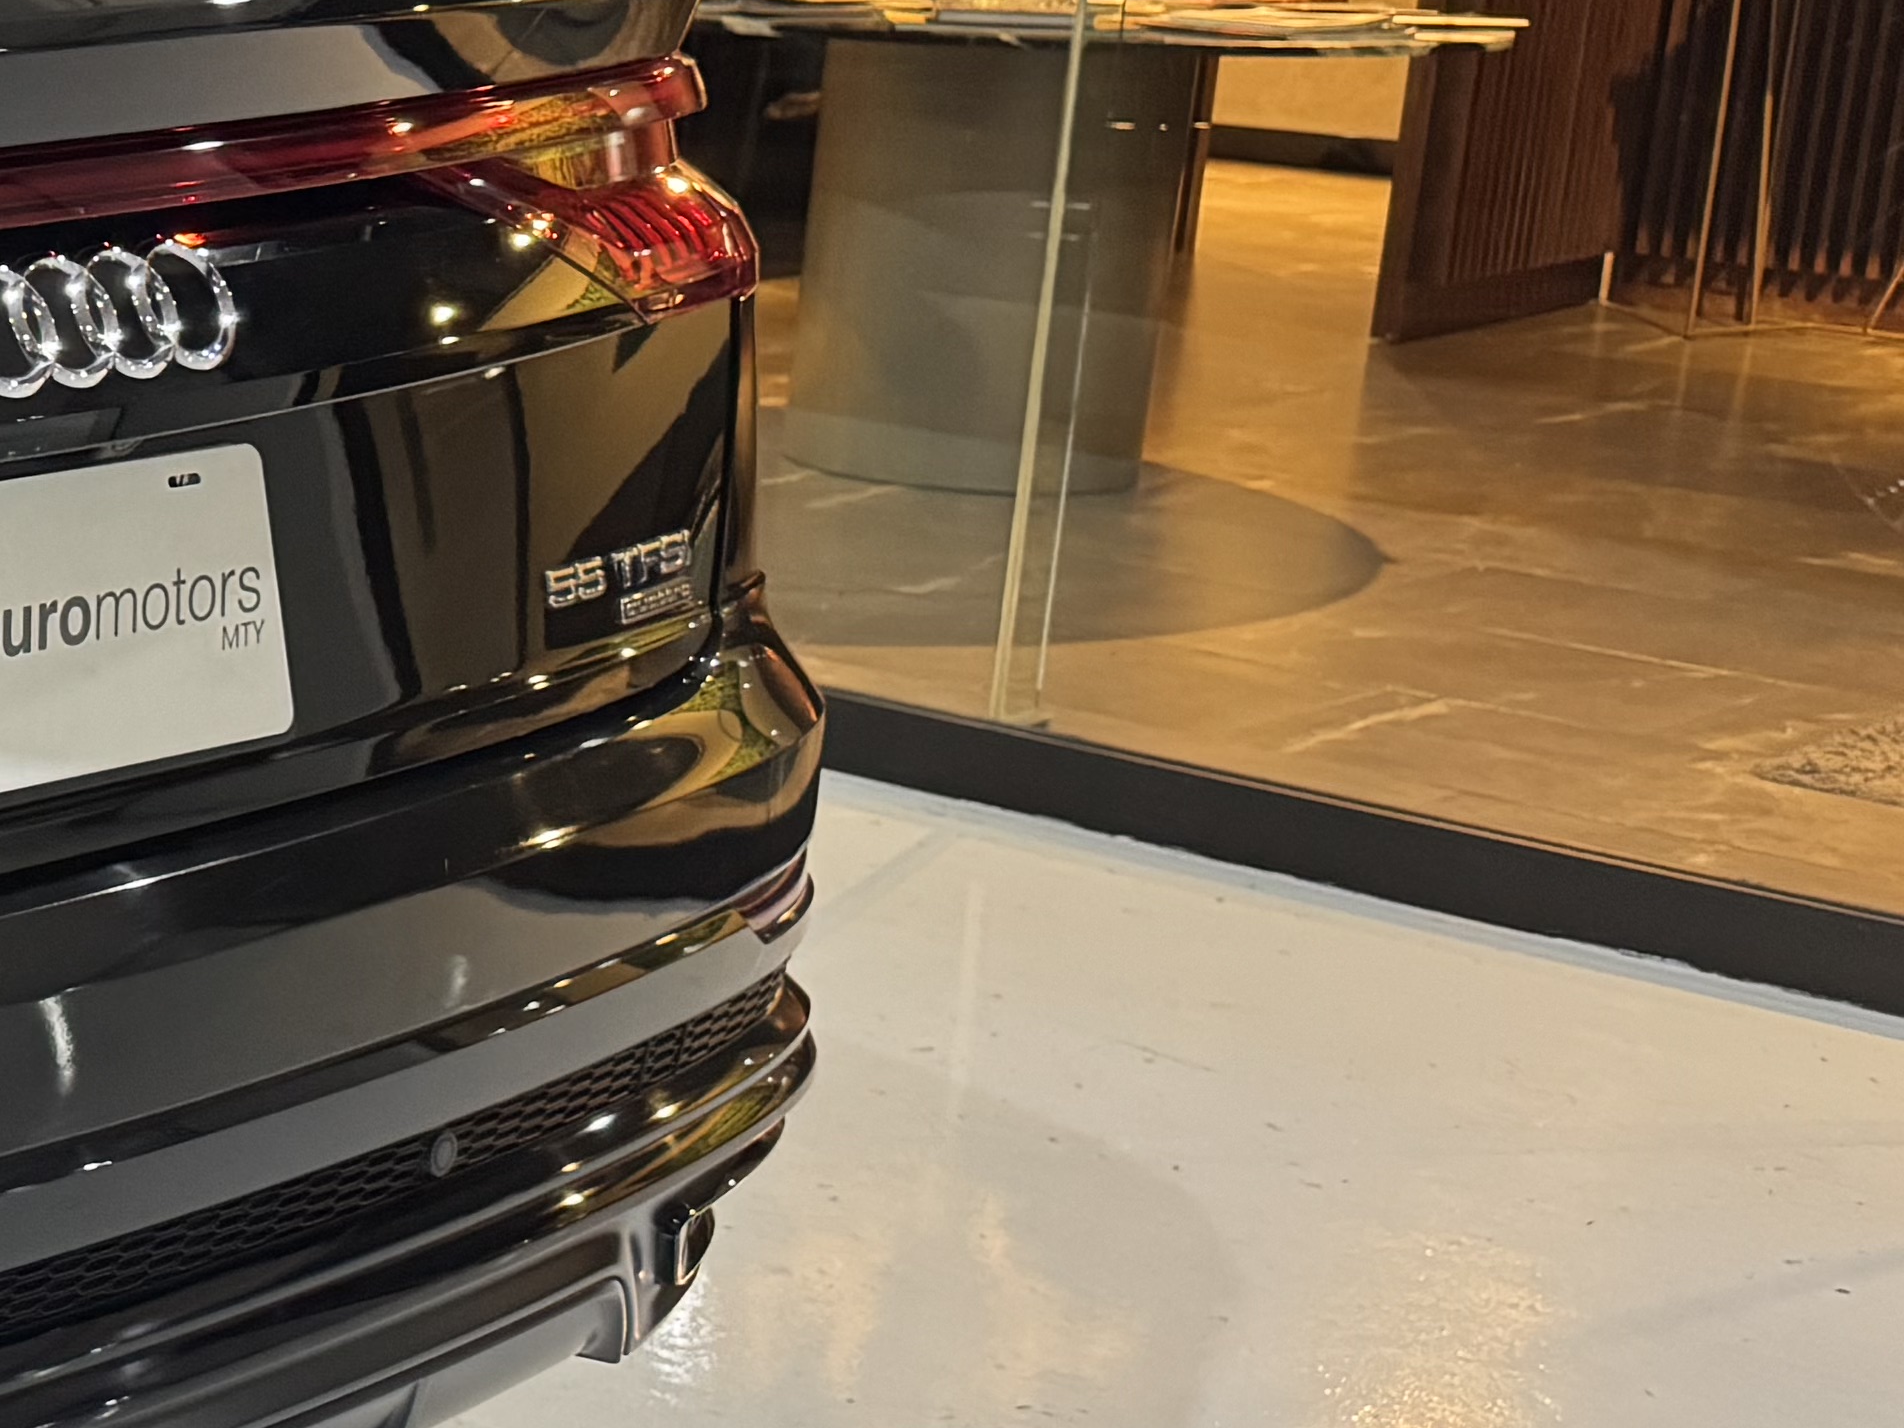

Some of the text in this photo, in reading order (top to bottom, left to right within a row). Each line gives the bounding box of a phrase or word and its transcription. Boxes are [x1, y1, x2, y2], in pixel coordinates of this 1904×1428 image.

[545, 556, 609, 609] 55
[611, 529, 692, 589] TFSI
[221, 619, 265, 652] MTY
